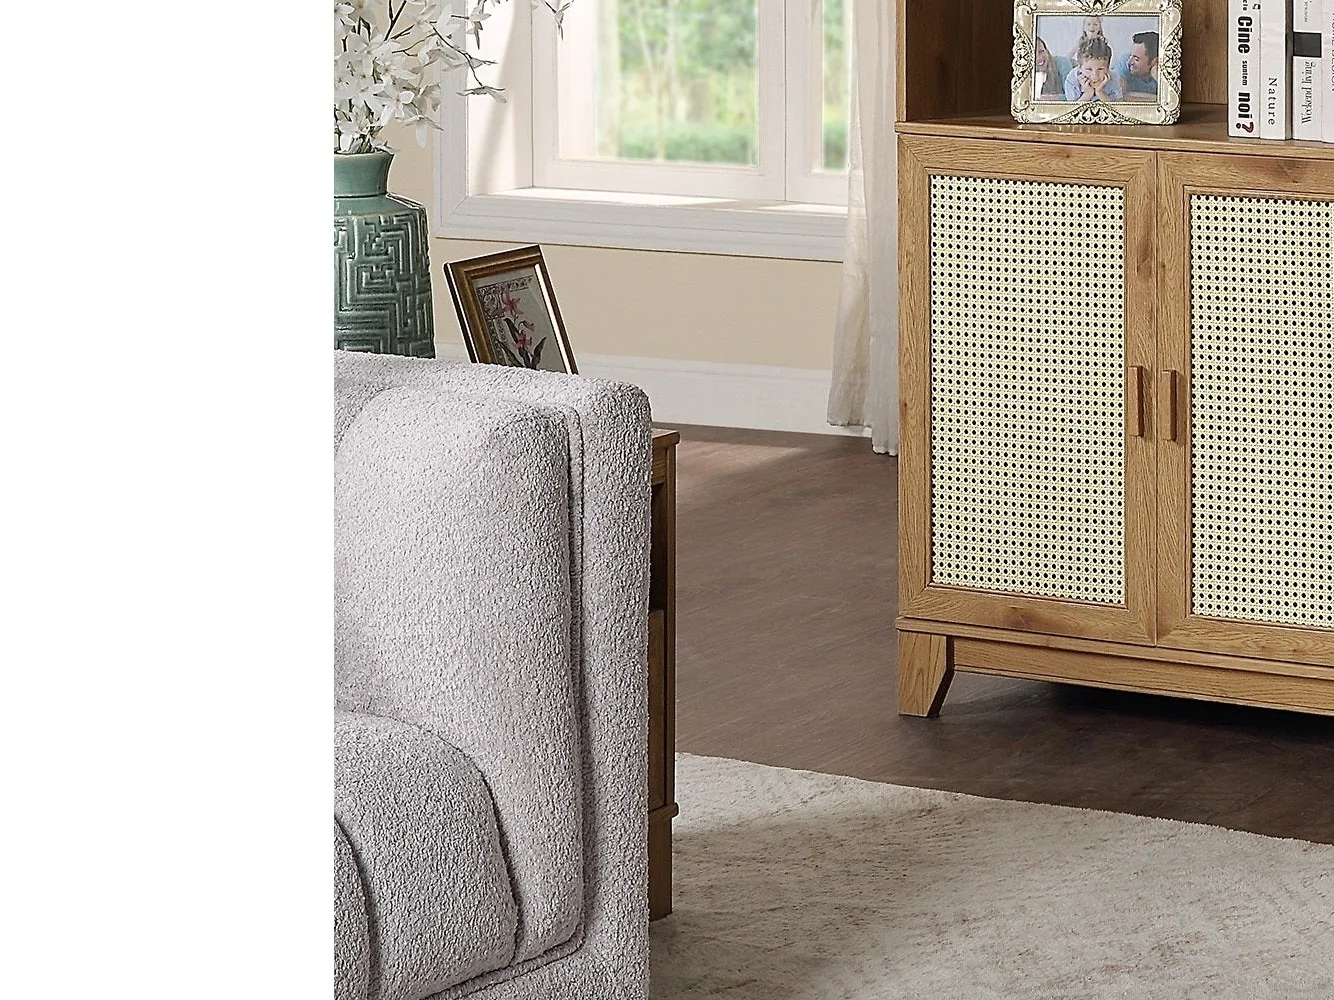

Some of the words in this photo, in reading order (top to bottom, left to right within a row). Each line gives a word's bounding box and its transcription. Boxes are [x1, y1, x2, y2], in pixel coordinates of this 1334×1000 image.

[1238, 16, 1253, 54] Cine
[1241, 60, 1249, 86] suntem
[1301, 61, 1316, 84] living
[1236, 92, 1254, 134] noi?
[1268, 77, 1278, 125] Nature
[1301, 87, 1313, 124] Weekend
